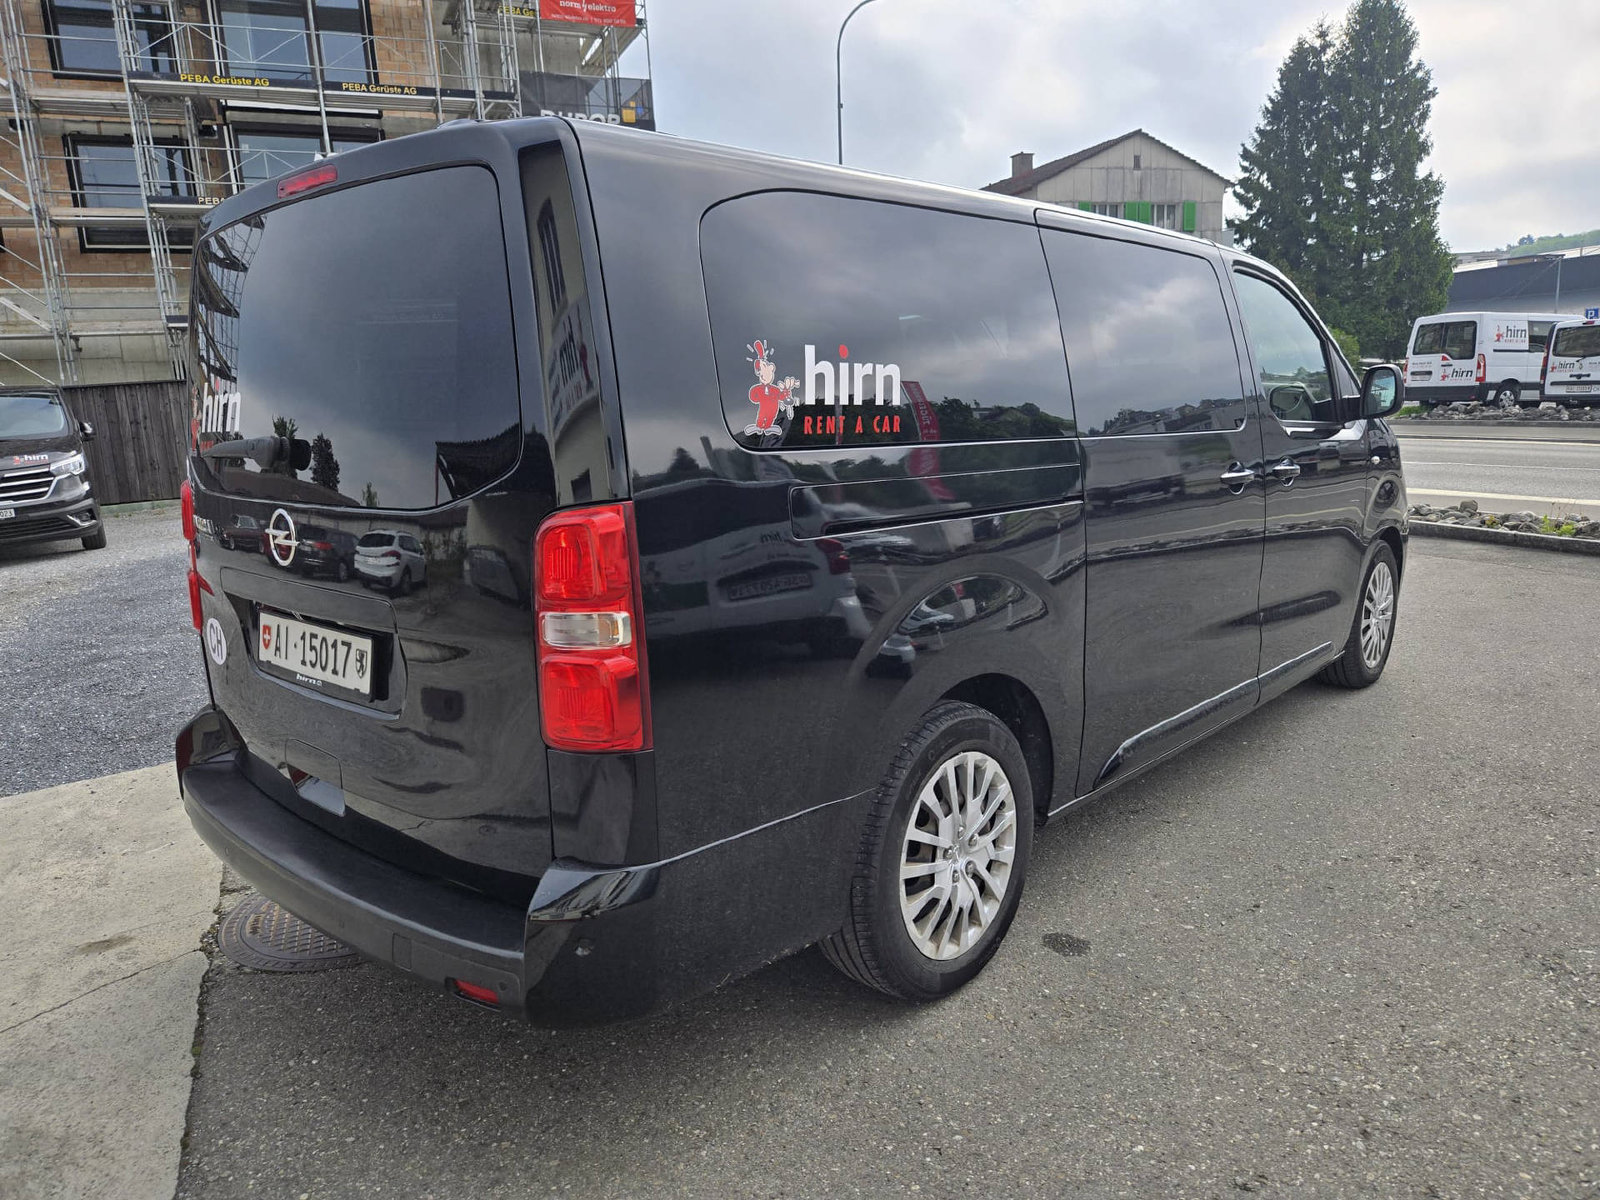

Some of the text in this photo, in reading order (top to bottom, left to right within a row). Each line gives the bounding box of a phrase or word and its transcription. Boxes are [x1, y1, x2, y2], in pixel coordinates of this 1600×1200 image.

[180, 74, 270, 86] PEBA Gerüste AG
[342, 82, 418, 95] PEBA Gerüste AG
[1505, 325, 1527, 338] hirn
[804, 344, 901, 406] hirn
[1451, 368, 1473, 378] hirn
[202, 379, 241, 433] hirn
[803, 415, 901, 435] RENT A CAR
[208, 623, 224, 660] CH
[274, 623, 353, 679] AI 15017
[296, 673, 317, 684] hirn
